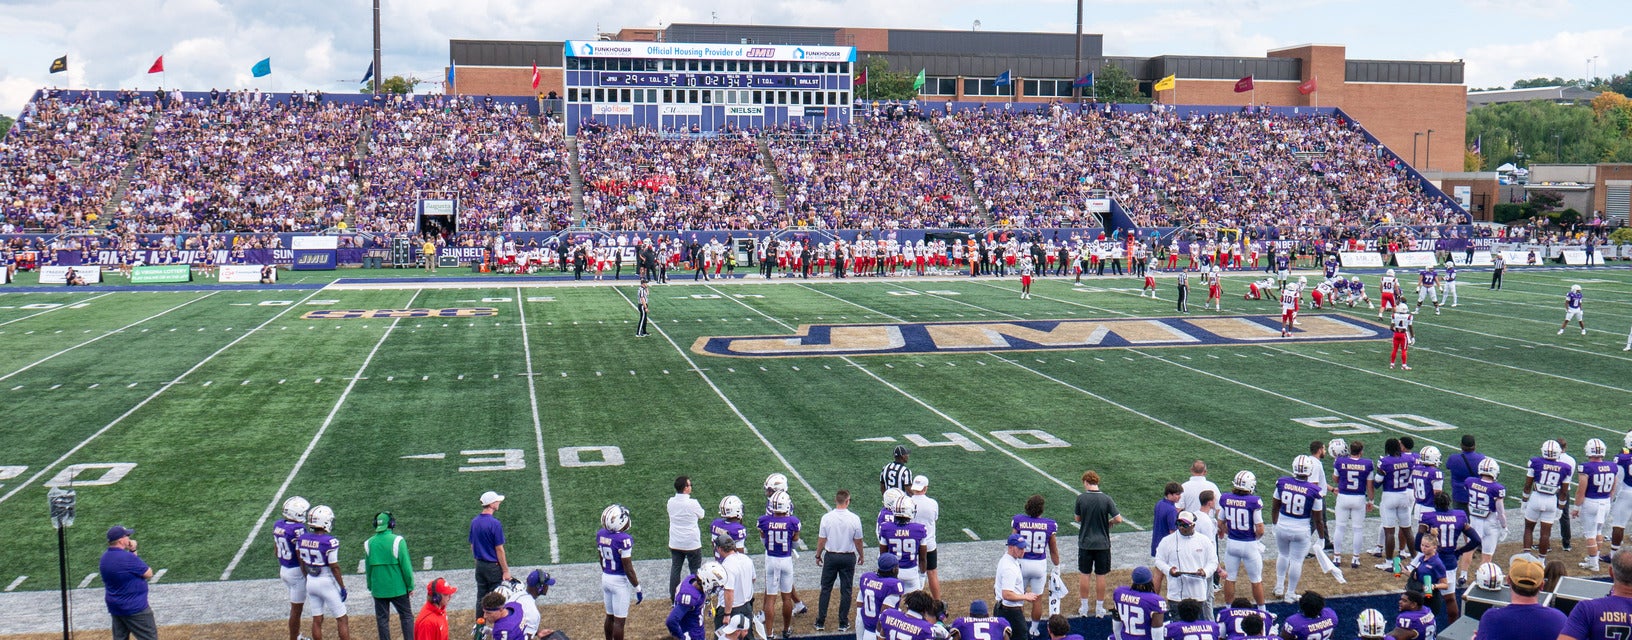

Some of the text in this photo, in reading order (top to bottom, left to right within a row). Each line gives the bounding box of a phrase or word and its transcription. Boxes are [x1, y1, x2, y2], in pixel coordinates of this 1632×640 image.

[647, 47, 742, 57] Official Housing Provider of
[746, 48, 775, 58] JMU
[625, 75, 638, 84] 29
[671, 78, 676, 86] 2
[688, 78, 696, 87] 10
[728, 78, 739, 87] 34
[747, 79, 752, 87] 2
[274, 250, 294, 259] SUN
[298, 253, 329, 264] JMU
[442, 248, 485, 257] SUN BELT
[1284, 295, 1292, 304] 10
[691, 313, 1392, 357] JMU
[1291, 414, 1459, 435] 50
[903, 430, 1072, 451] 40
[458, 446, 625, 472] 30
[888, 470, 896, 485] S
[1347, 471, 1359, 489] 5
[1393, 469, 1410, 488] 12
[1540, 471, 1560, 486] 18
[1593, 473, 1615, 493] 48
[1413, 478, 1426, 500] 18
[1226, 498, 1246, 508] SNYDER
[1281, 491, 1306, 515] 98
[1469, 489, 1490, 511] 22
[1019, 522, 1048, 531] HOLLANDER
[1224, 507, 1250, 531] 40
[768, 530, 788, 552] 14
[1439, 523, 1455, 547] 11
[889, 538, 916, 561] 39
[867, 580, 882, 590] JONES
[864, 589, 876, 618] 0
[1120, 594, 1140, 604] BANKS
[885, 615, 921, 634] WEATHERSBY
[1118, 603, 1146, 636] 42
[1399, 618, 1411, 628] 97
[1600, 612, 1626, 622] JOSH
[974, 623, 991, 640] 5
[1182, 625, 1213, 634] McMULLIN
